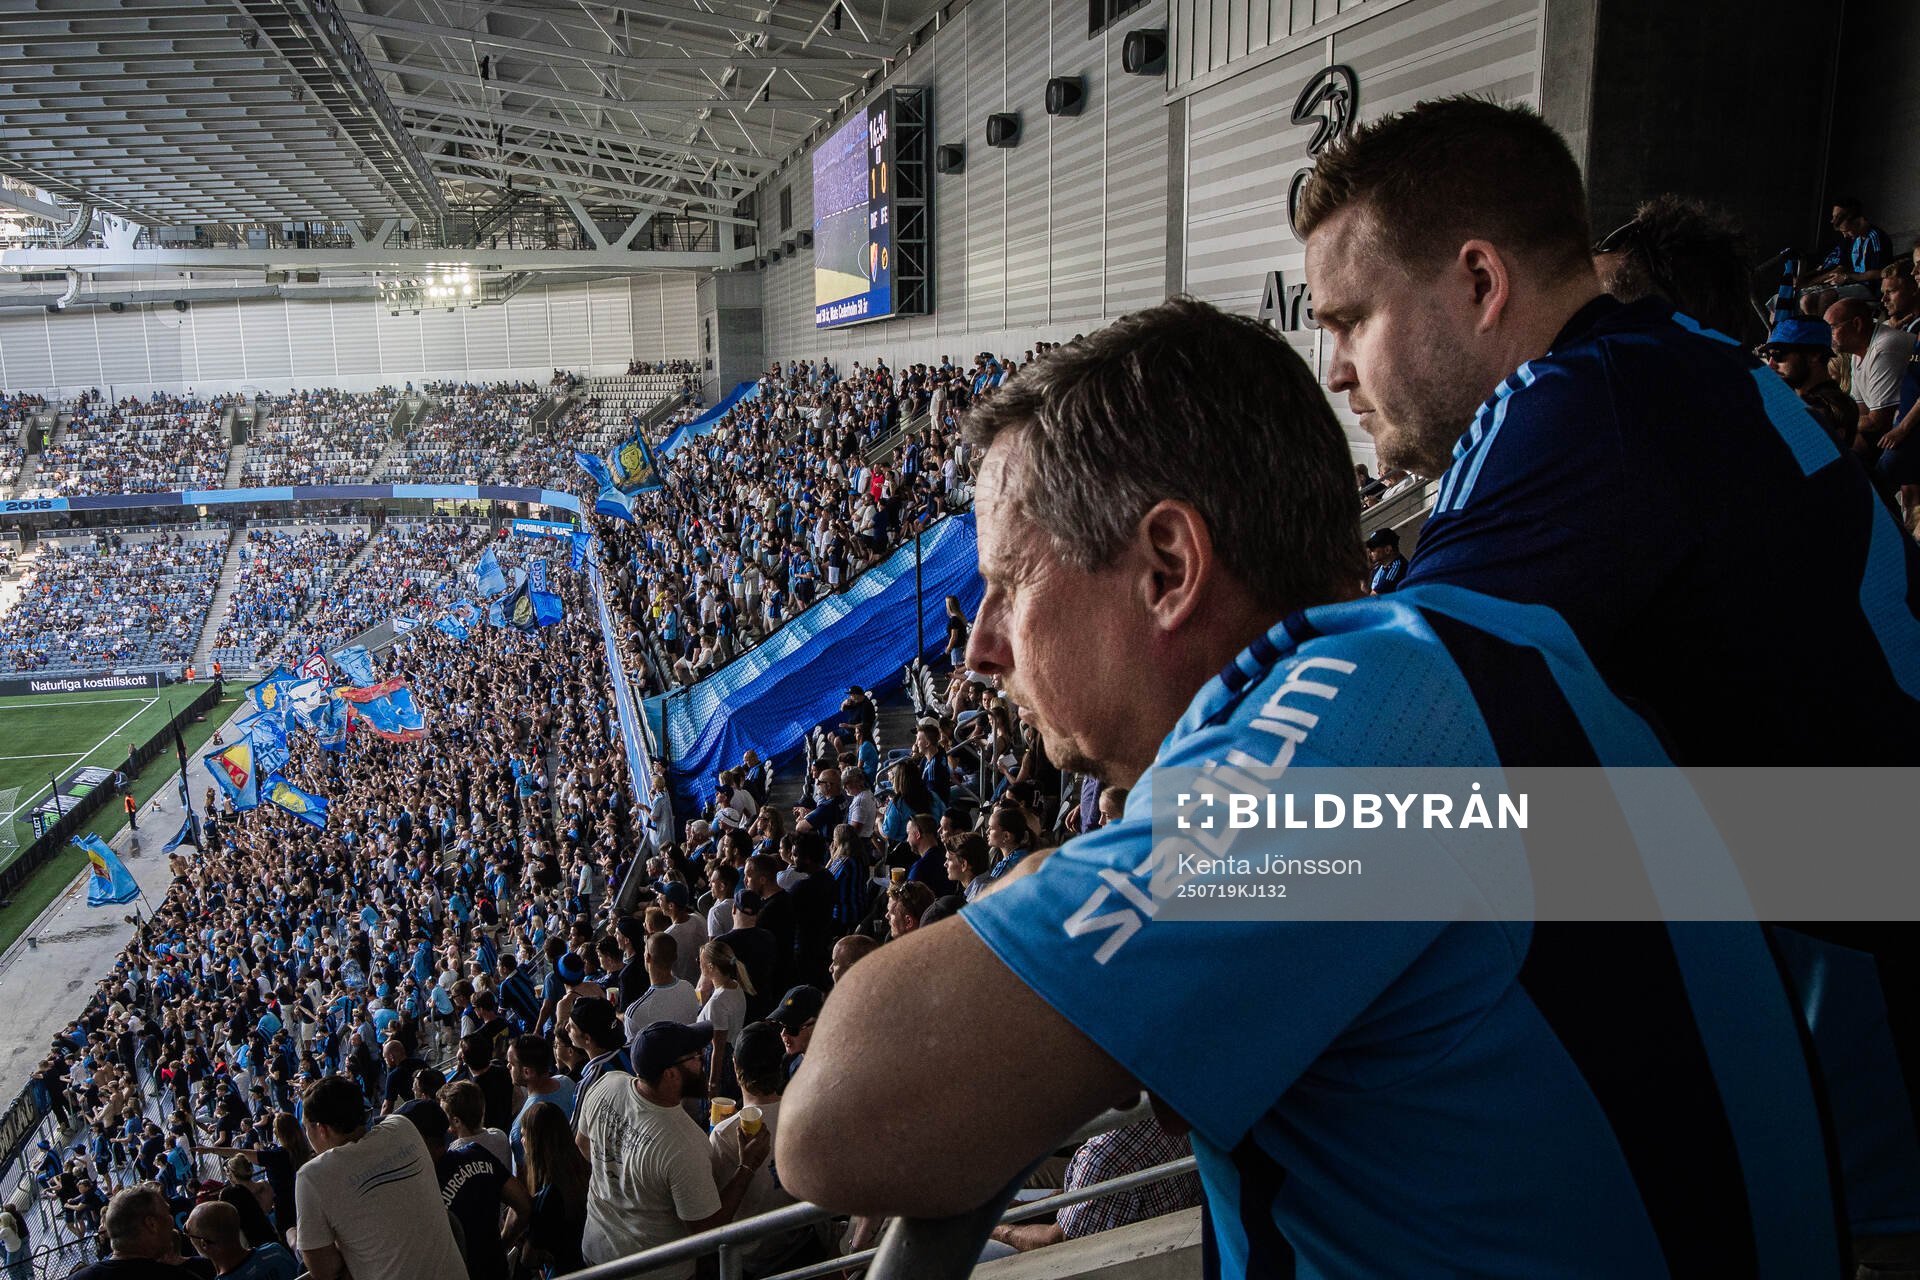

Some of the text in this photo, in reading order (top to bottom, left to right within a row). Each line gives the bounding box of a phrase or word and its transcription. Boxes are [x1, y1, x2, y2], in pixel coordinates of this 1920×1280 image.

[871, 161, 887, 199] 1 0
[1258, 271, 1320, 332] Are
[5, 500, 52, 511] 2018
[31, 675, 147, 691] Naturliga kosttillskott
[440, 1161, 494, 1210] JURGÅRDEN
